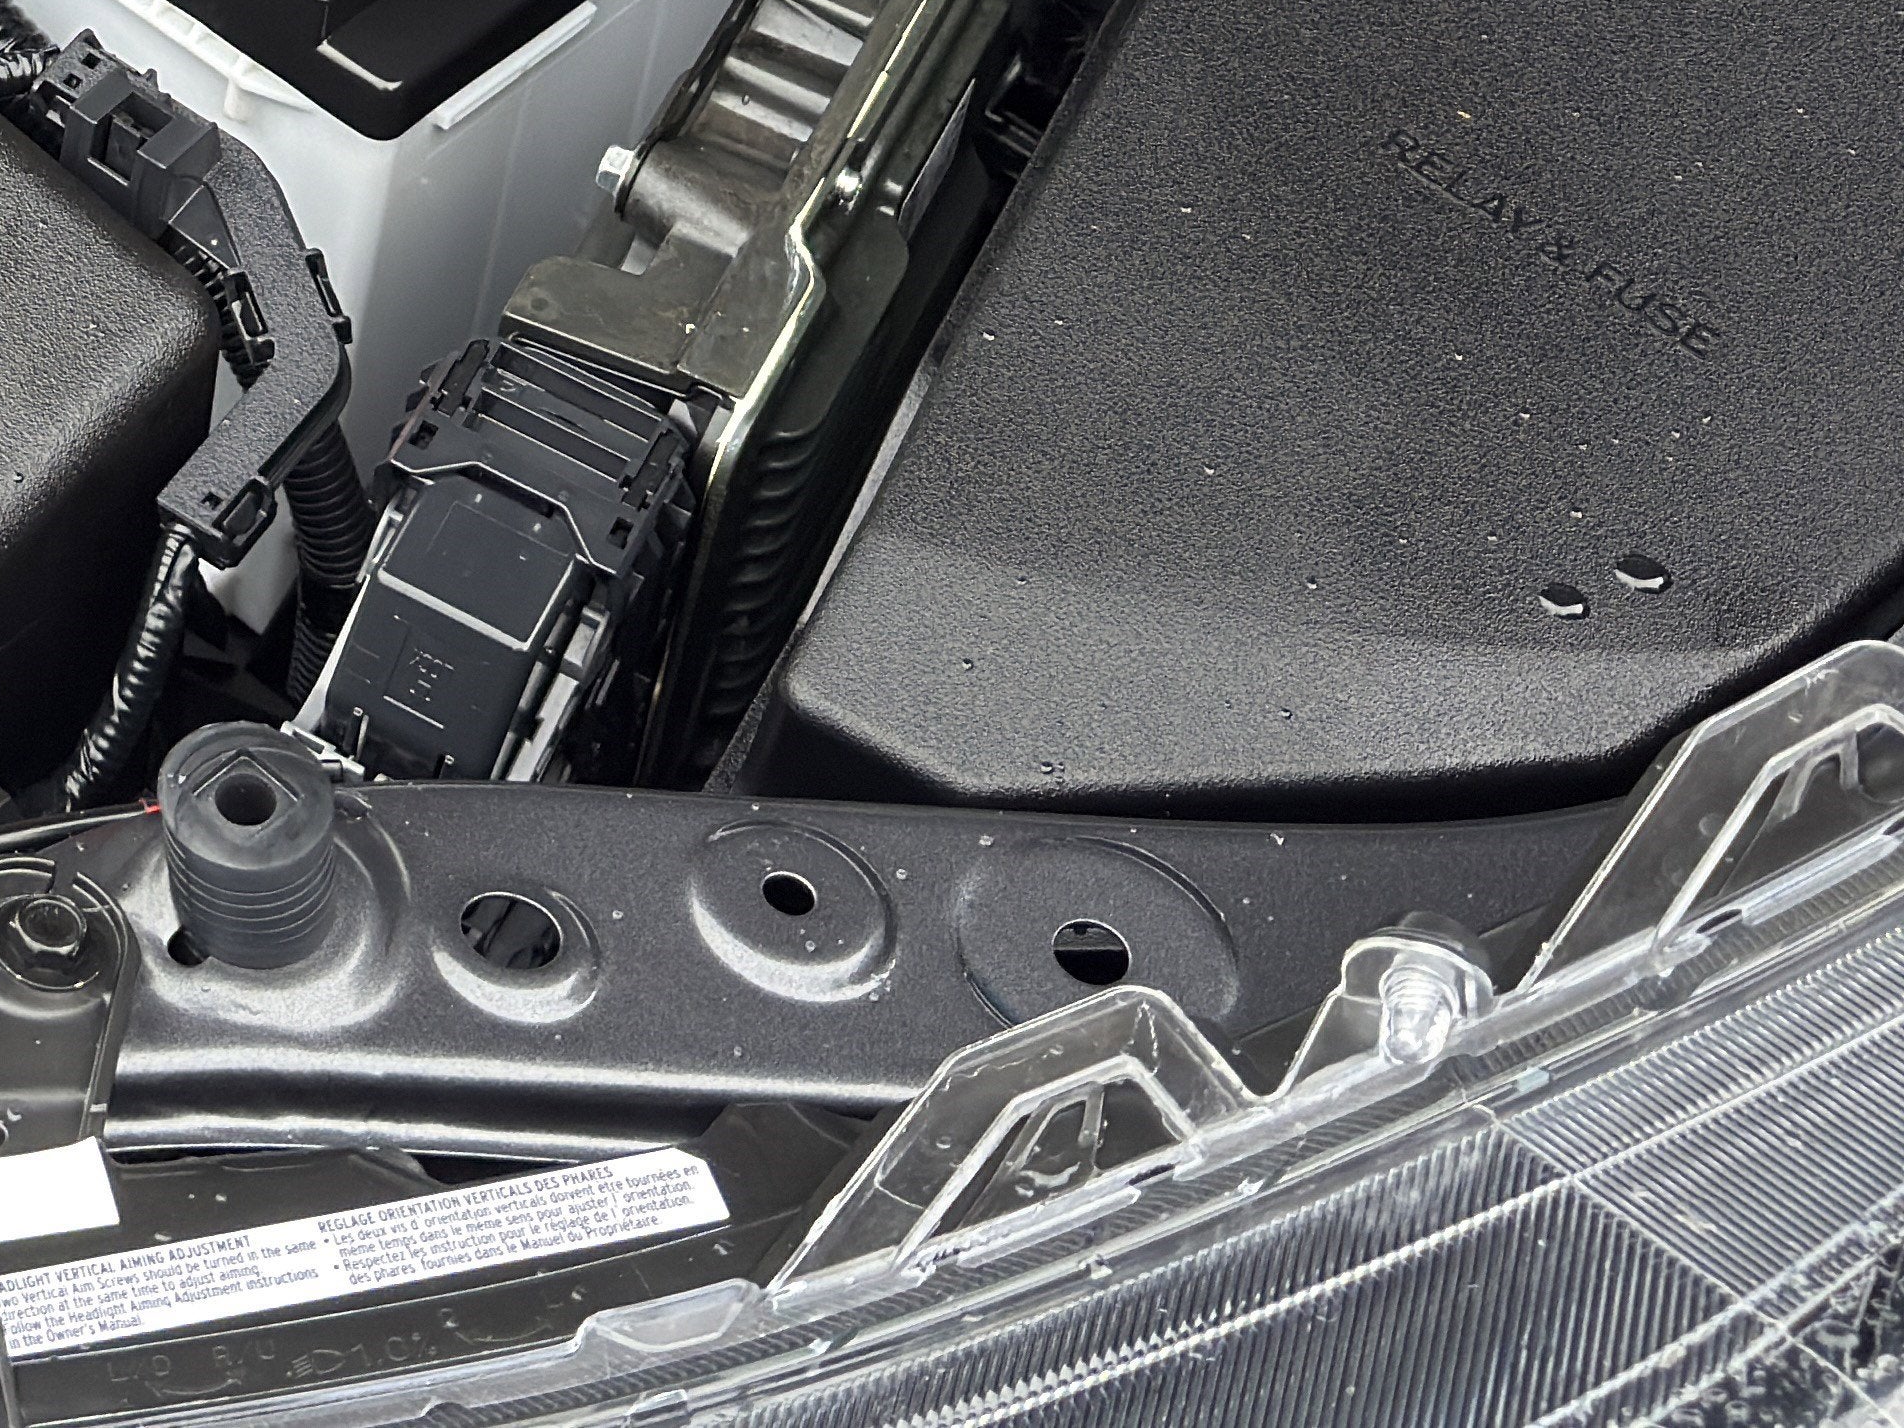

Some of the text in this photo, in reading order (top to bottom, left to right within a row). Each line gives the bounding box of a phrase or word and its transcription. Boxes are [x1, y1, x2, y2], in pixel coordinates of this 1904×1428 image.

[1585, 261, 1721, 361] FUSE
[332, 1229, 355, 1245] Les
[356, 1224, 387, 1241] deux
[389, 1221, 408, 1234] vis
[492, 1192, 547, 1214] verticals
[548, 1183, 595, 1204] doivent
[377, 1194, 462, 1222] ORIENTATION
[462, 1180, 533, 1206] VERTICALS
[533, 1174, 560, 1192] DES
[561, 1164, 614, 1187] PHARES
[342, 1247, 407, 1274] Respectez
[408, 1242, 427, 1258] les
[498, 1226, 527, 1243] pour
[377, 1232, 418, 1253] temps
[418, 1226, 449, 1243] dans
[504, 1211, 534, 1226] sens
[535, 1206, 563, 1222] pour
[566, 1195, 610, 1216] ajuster
[21, 1283, 69, 1304] Vertical
[70, 1278, 95, 1294] Aim
[96, 1269, 140, 1290] Screws
[142, 1262, 183, 1281] should
[202, 1251, 244, 1270] turned
[260, 1244, 282, 1259] the
[283, 1238, 317, 1255] same
[53, 1260, 116, 1283] VERTICAL
[117, 1250, 165, 1270] AIMING
[167, 1234, 251, 1262] ADJUSTMENT
[347, 1269, 372, 1286] des
[373, 1261, 416, 1282] phares
[473, 1243, 503, 1260] dans
[519, 1231, 564, 1251] Manuel
[43, 1313, 66, 1328] the
[67, 1301, 127, 1327] Headlight
[173, 1279, 243, 1305] Adjustment
[244, 1265, 319, 1291] instructions
[71, 1293, 94, 1308] the
[96, 1287, 128, 1304] same
[130, 1281, 159, 1298] time
[177, 1271, 216, 1291] adjust
[22, 1331, 44, 1346] the
